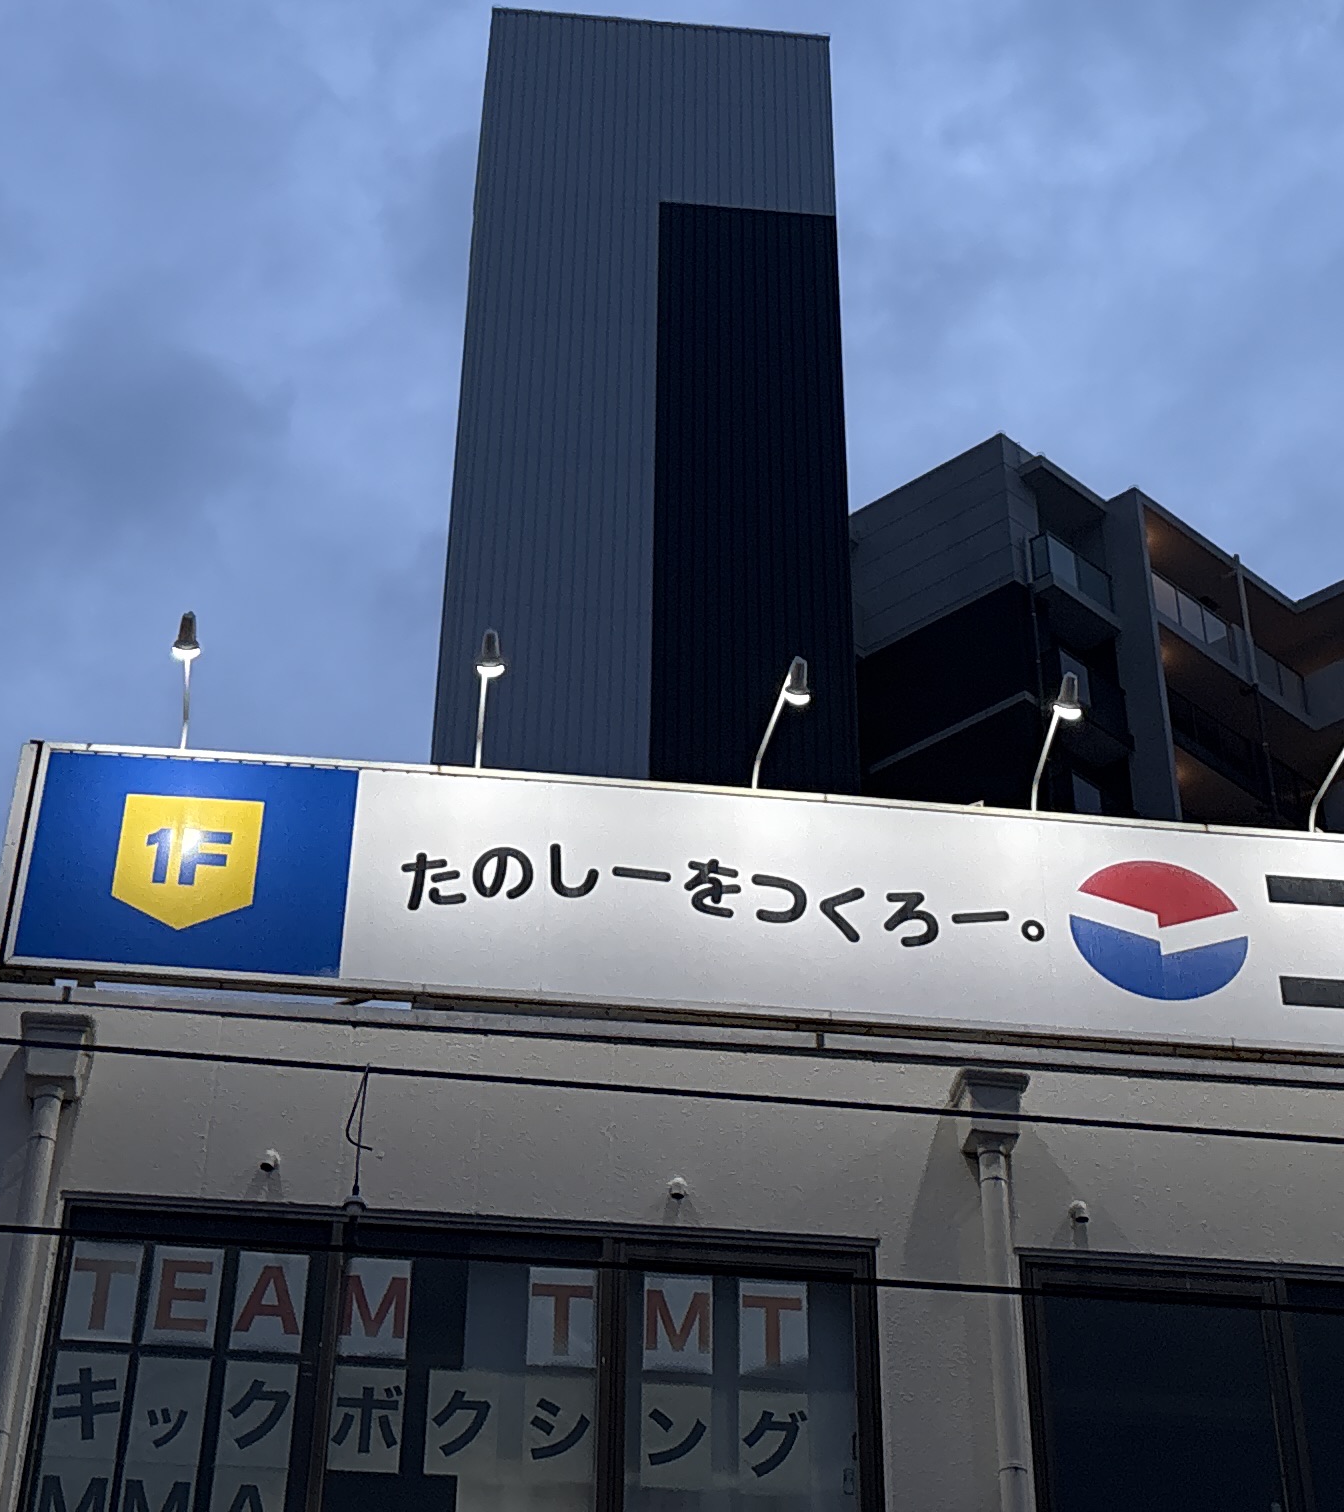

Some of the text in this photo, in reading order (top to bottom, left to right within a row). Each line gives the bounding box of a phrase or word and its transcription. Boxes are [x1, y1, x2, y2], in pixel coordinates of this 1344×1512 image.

[146, 828, 233, 885] 1F
[401, 844, 1045, 947] たのしーをつくろー。
[74, 1257, 803, 1366] TEAM TMT
[52, 1366, 807, 1478] キックボクシング
